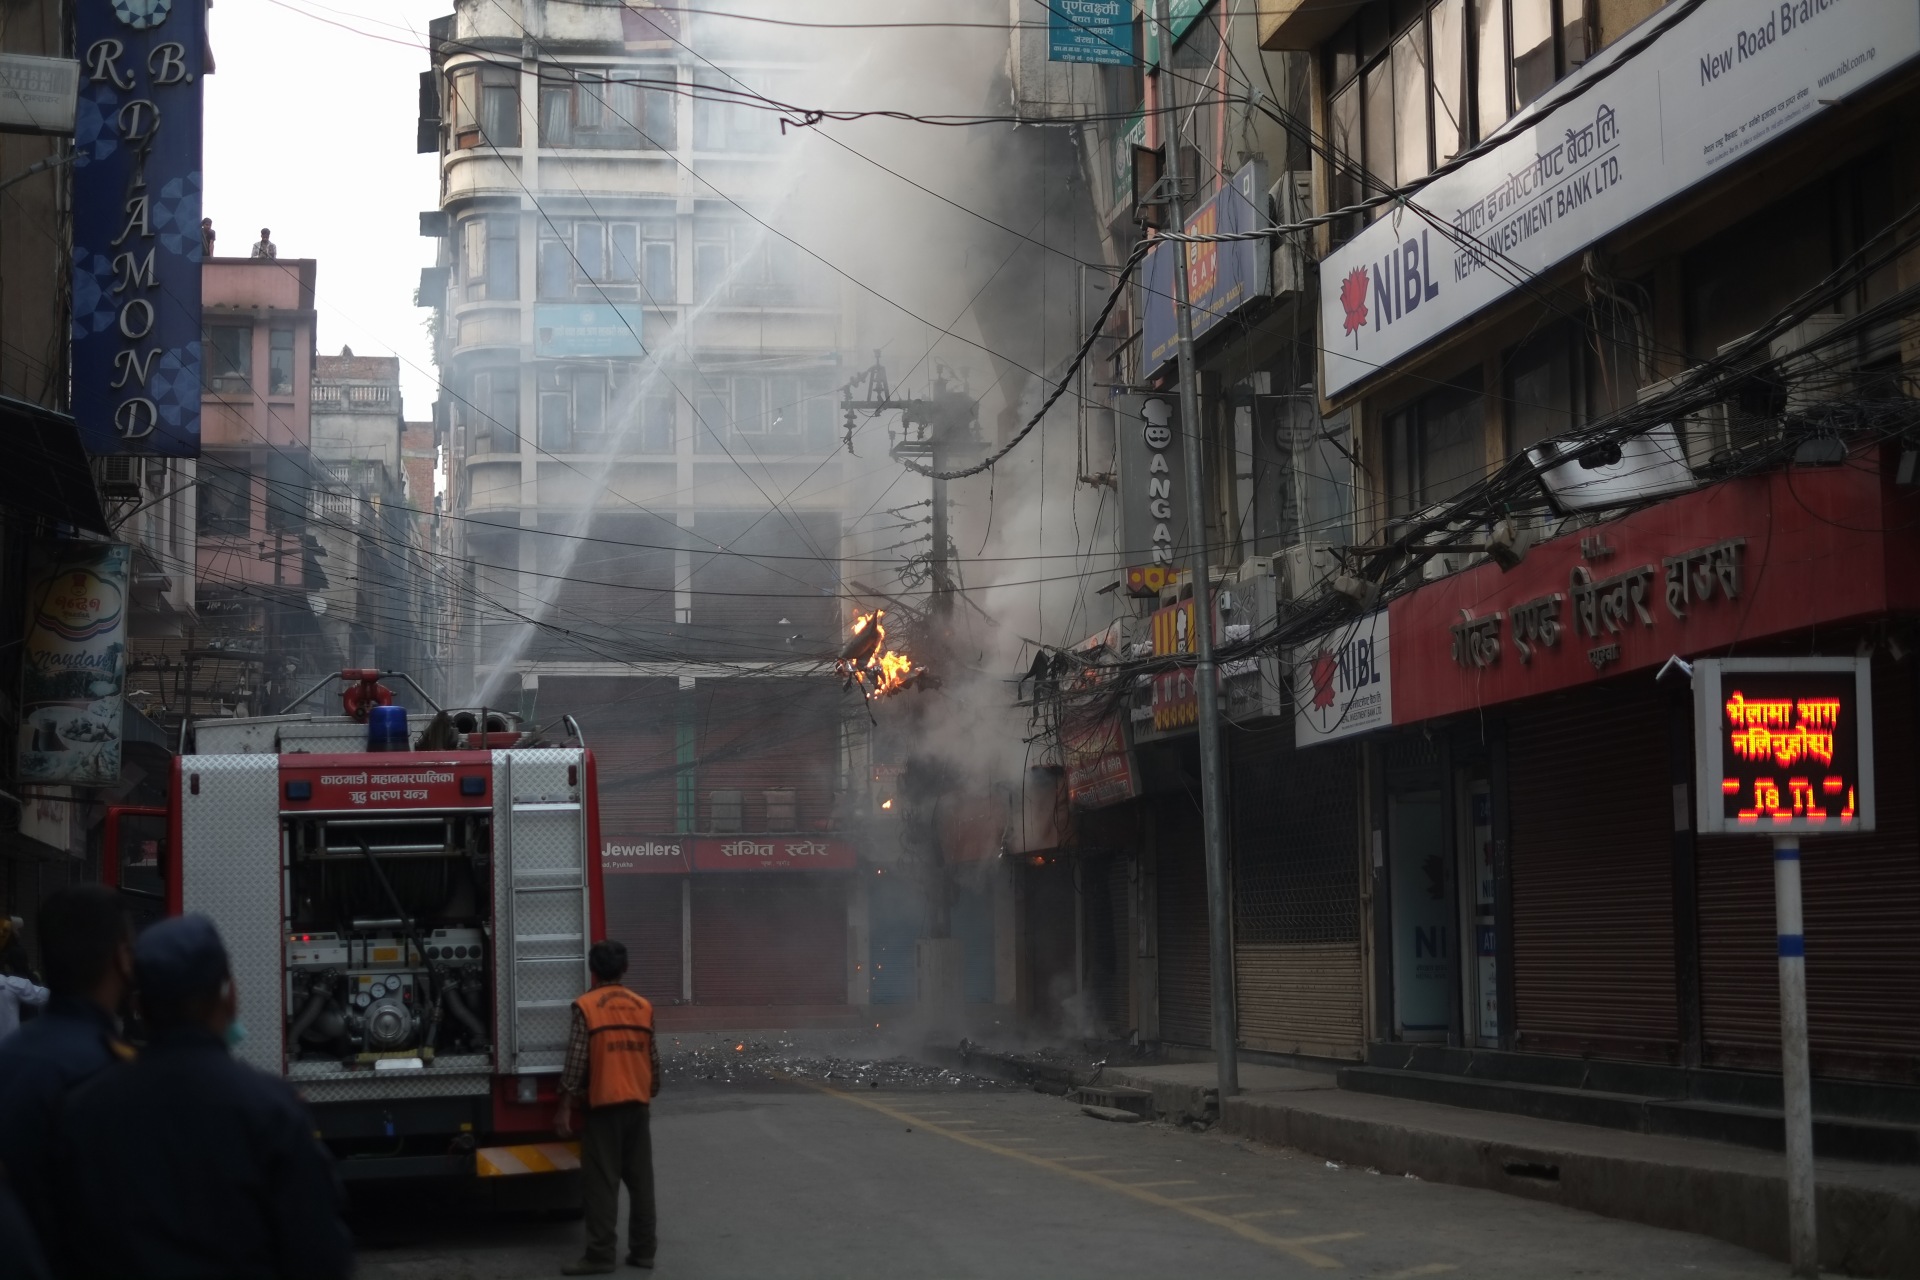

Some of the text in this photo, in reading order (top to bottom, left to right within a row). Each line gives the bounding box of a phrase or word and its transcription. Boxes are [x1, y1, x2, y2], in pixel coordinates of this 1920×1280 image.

[86, 39, 193, 91] R. B.
[1699, 0, 1839, 86] New Road Branc
[1817, 46, 1876, 88] www.nibl.com.np
[1453, 200, 1485, 242] नेपाल
[1566, 124, 1593, 164] बैंक
[1596, 104, 1620, 148] लि.
[1454, 155, 1622, 283] NEPAL INVESTMENT BANK LTD.
[111, 98, 162, 440] DIAMOND
[1373, 228, 1439, 332] NIBL
[1149, 453, 1173, 566] ANGAN
[1450, 537, 1746, 669] गोल्ड एण्ड सिल्वर हाउस
[35, 650, 108, 670] Nandan
[1339, 636, 1380, 693] NIBL
[1797, 697, 1840, 729] भाग
[370, 770, 454, 785] महानगरपालिका
[403, 789, 428, 801] यन्त्र
[1755, 788, 1780, 809] 18
[602, 842, 681, 857] Jewellers
[721, 841, 775, 856] संगित
